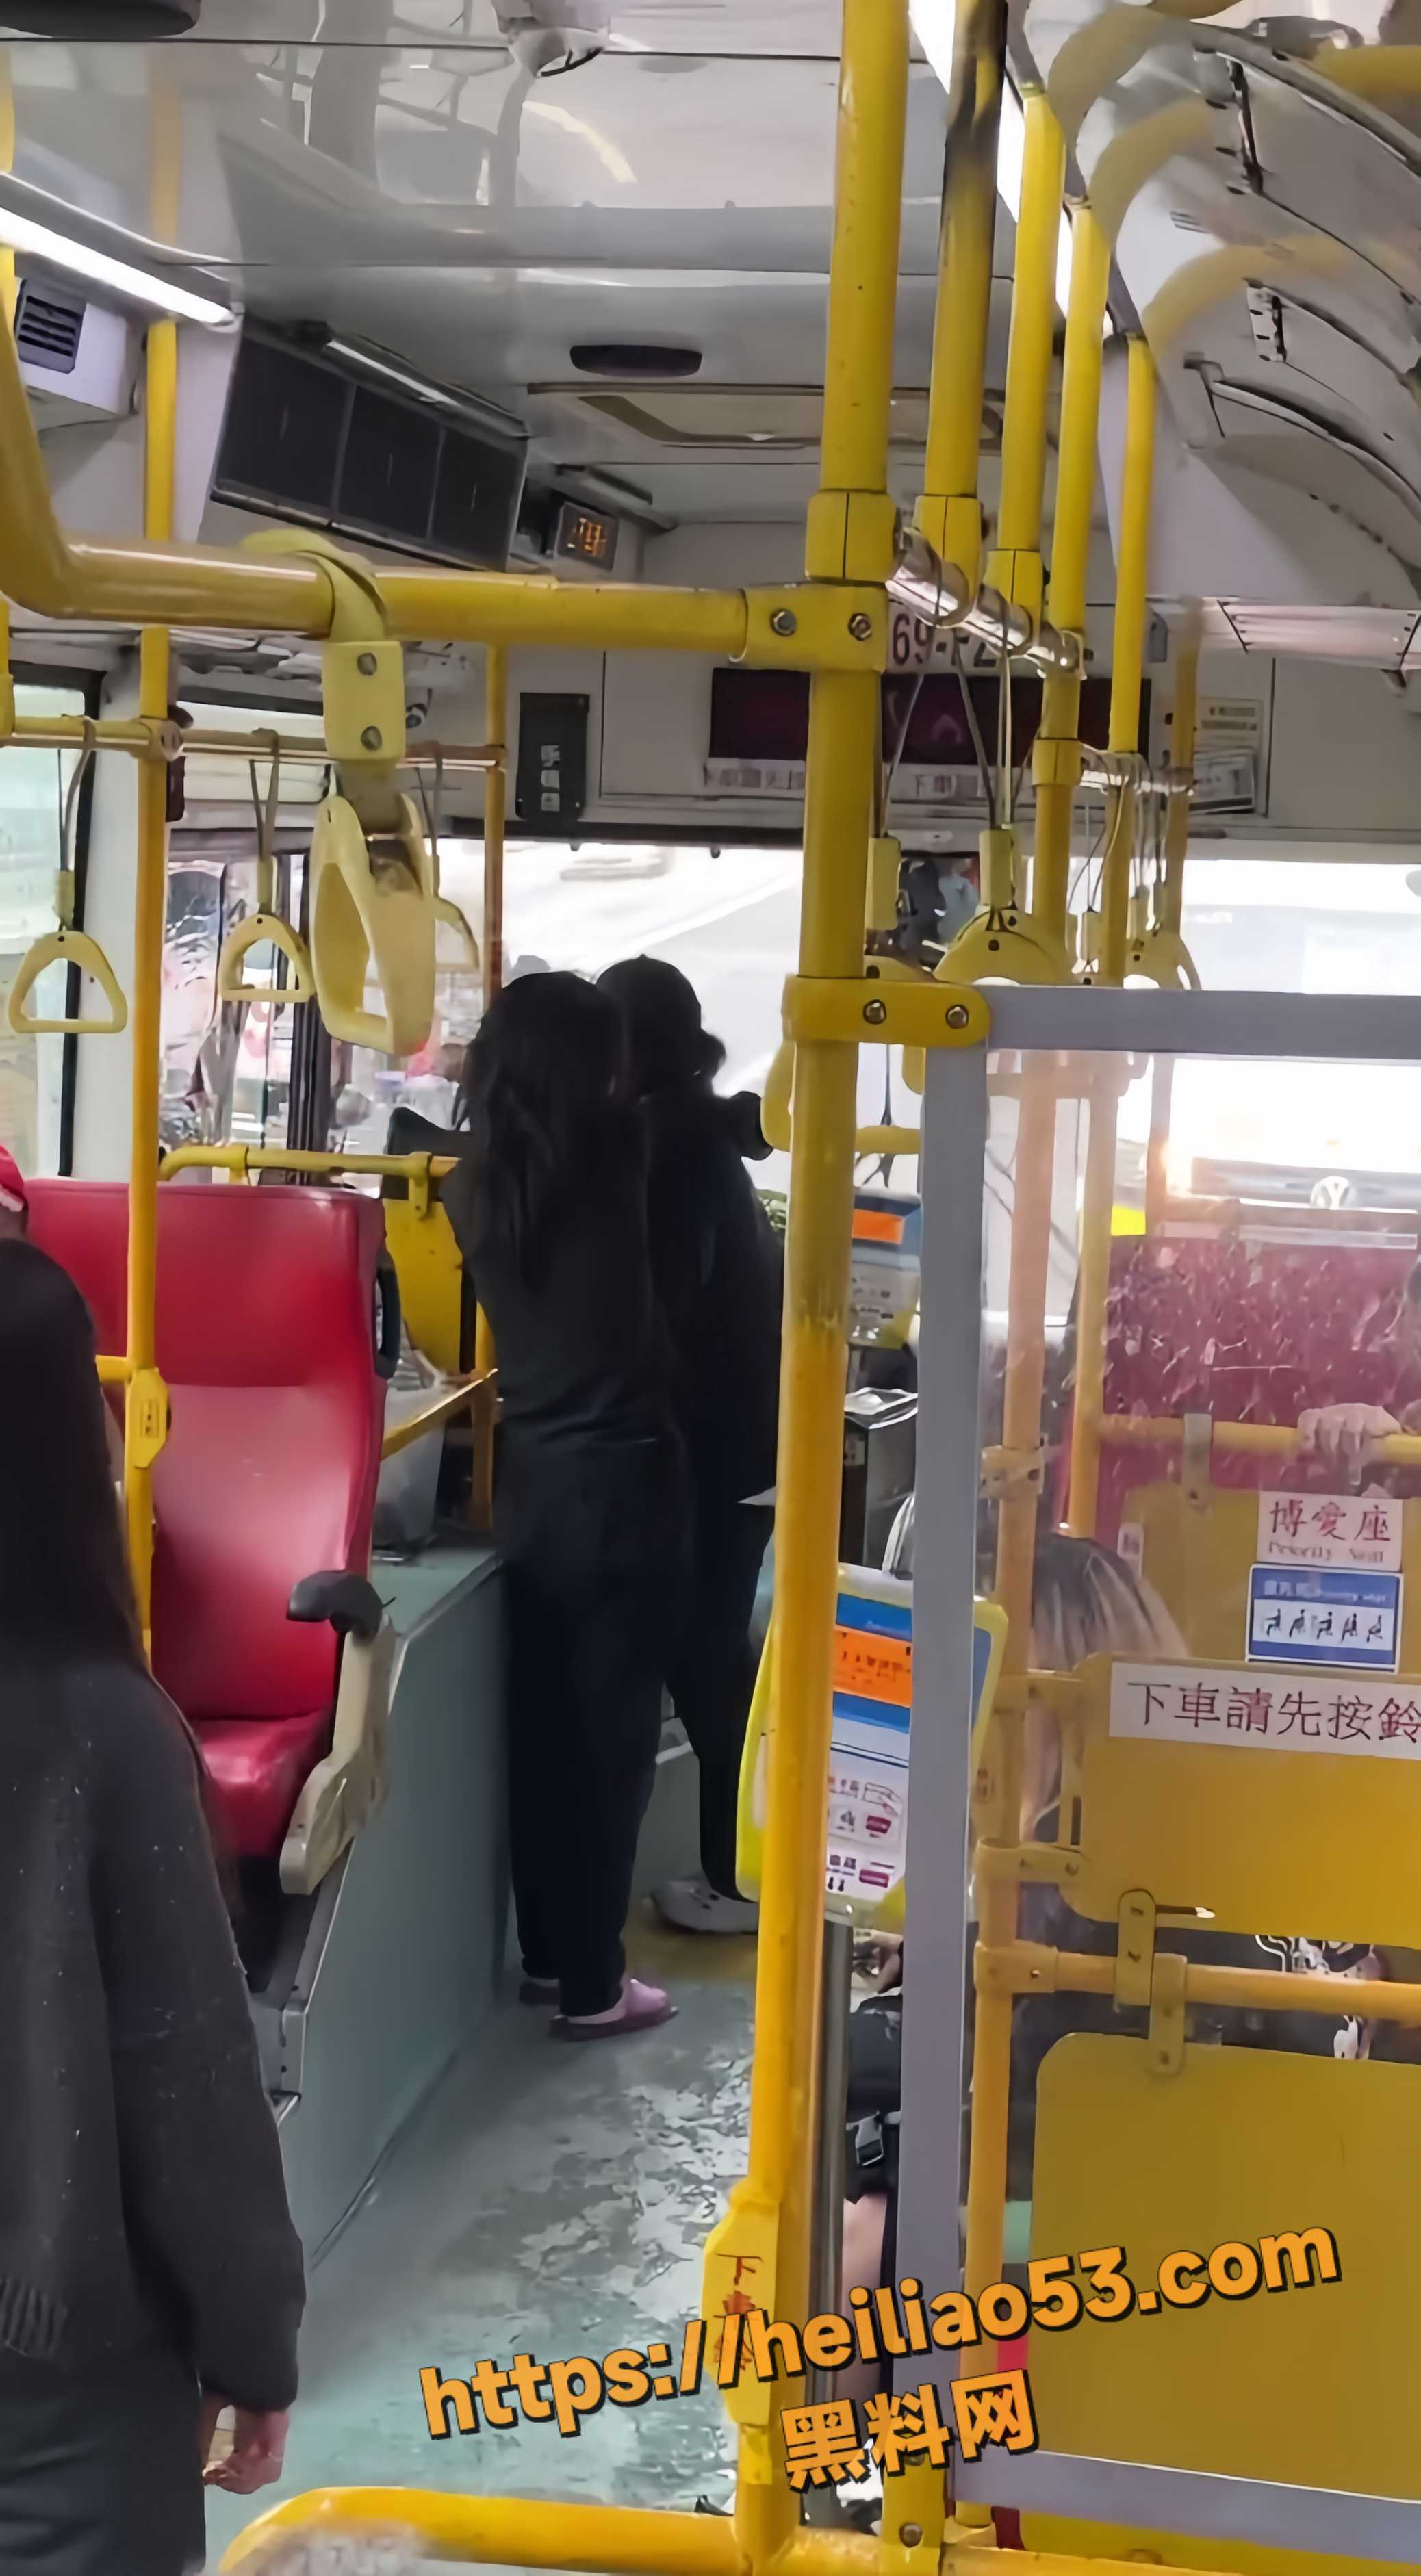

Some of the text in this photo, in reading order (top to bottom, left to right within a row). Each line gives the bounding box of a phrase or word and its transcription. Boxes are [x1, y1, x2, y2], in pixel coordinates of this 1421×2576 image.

[1270, 1499, 1391, 1541] 博愛座
[1127, 1682, 1421, 1743] 下車請先按鈴
